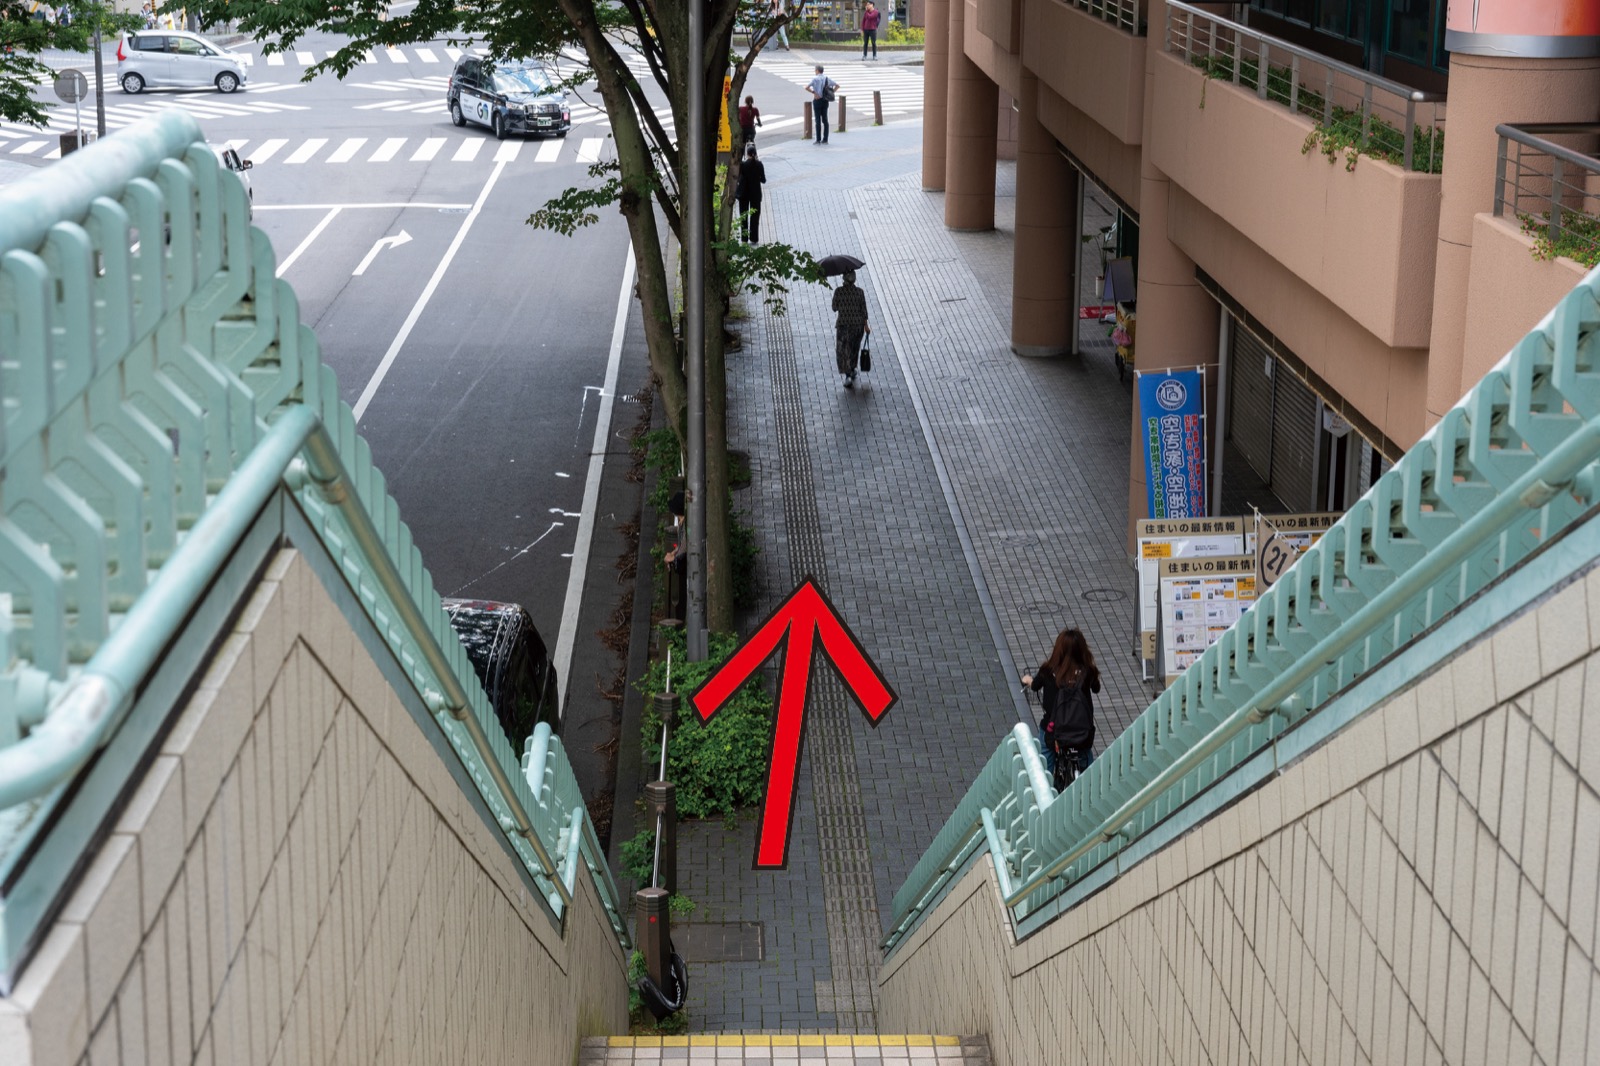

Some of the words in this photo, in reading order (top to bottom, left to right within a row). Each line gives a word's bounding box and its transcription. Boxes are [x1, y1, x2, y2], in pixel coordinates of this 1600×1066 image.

[1145, 521, 1235, 534] 住まいの最新情報
[1168, 559, 1255, 573] 住まいの最新情
[1267, 546, 1287, 575] 21
